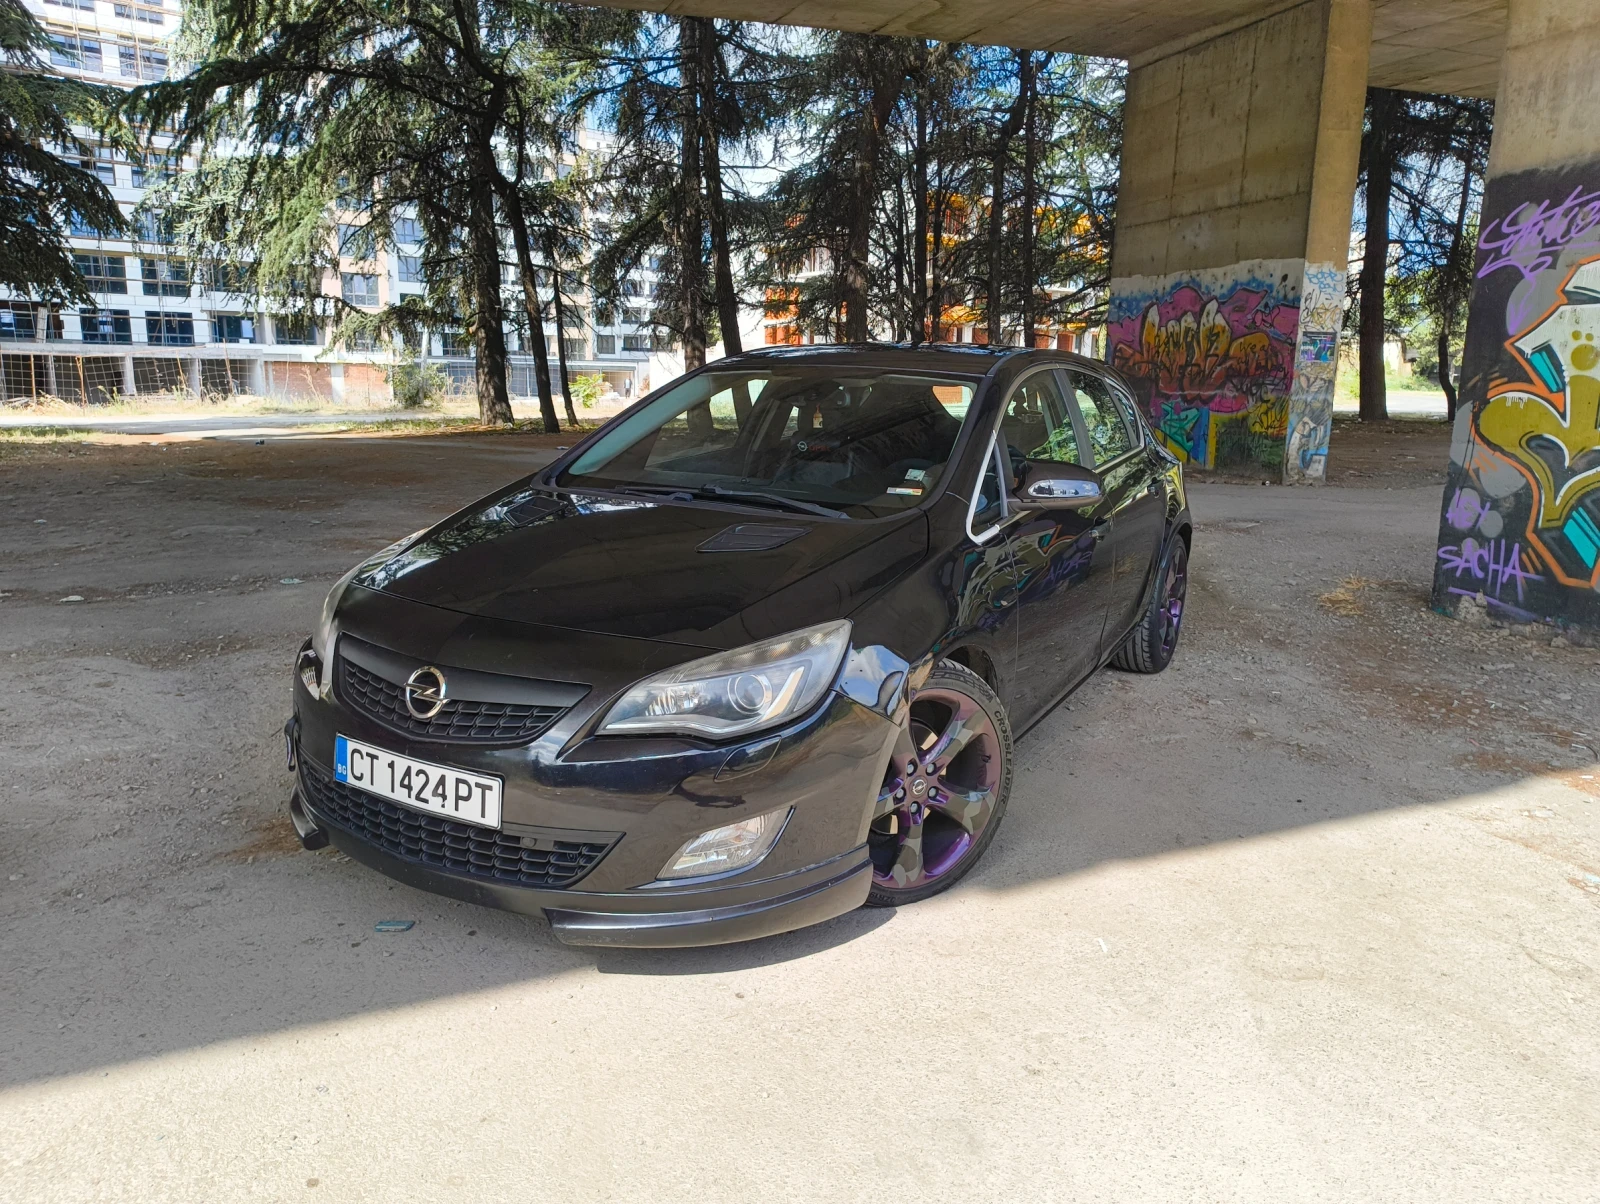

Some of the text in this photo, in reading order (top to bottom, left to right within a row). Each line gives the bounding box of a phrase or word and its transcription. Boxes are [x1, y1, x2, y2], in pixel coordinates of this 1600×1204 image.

[1437, 539, 1540, 601] SACHA
[337, 763, 347, 775] BG
[994, 709, 1013, 804] CROSSLEADER
